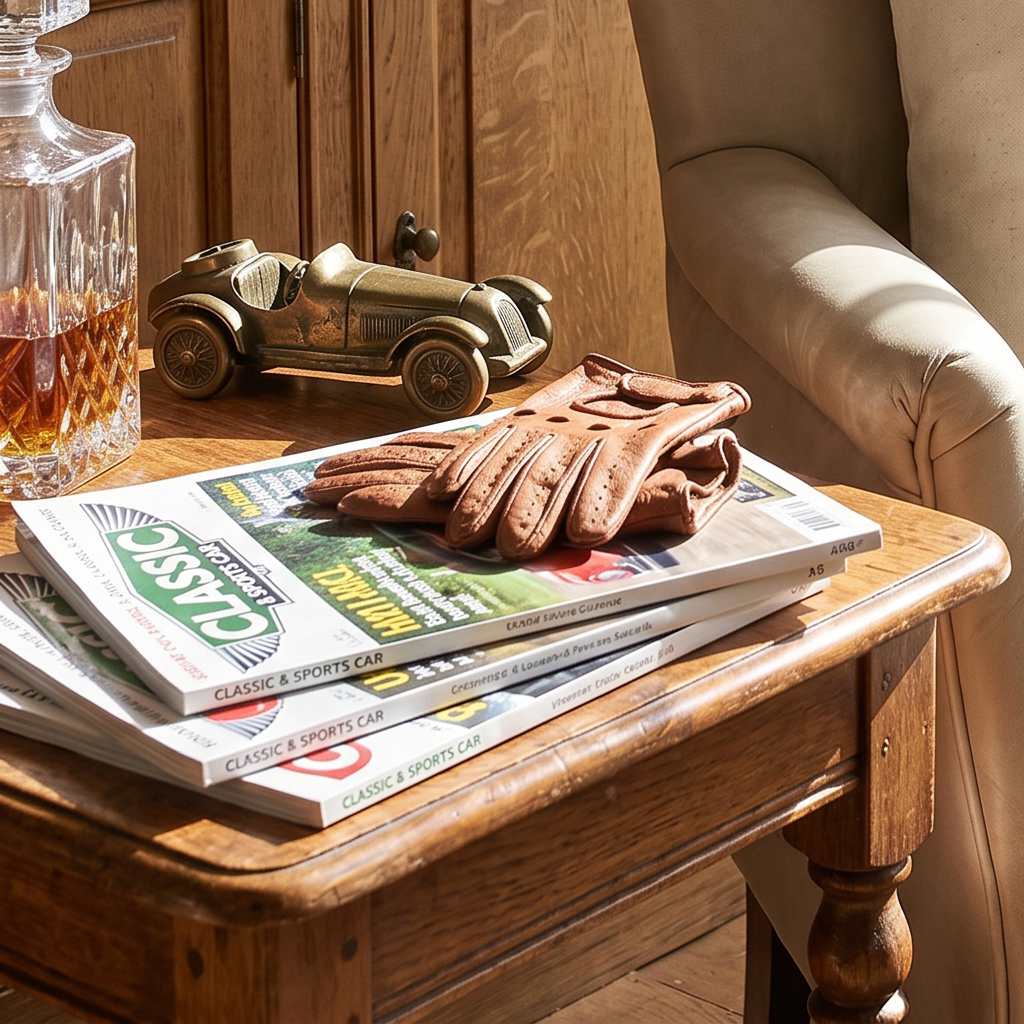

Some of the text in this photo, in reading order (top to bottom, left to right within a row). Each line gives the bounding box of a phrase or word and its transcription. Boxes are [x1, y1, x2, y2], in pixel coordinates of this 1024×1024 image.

[116, 526, 269, 641] CLASSIC
[197, 542, 231, 565] CAR
[214, 652, 384, 701] CLASSIC & SPORTS CAR
[225, 709, 385, 773] CLASSIC & SPORTS CAR
[342, 734, 482, 810] CLASSIC & SPORTS CAR
